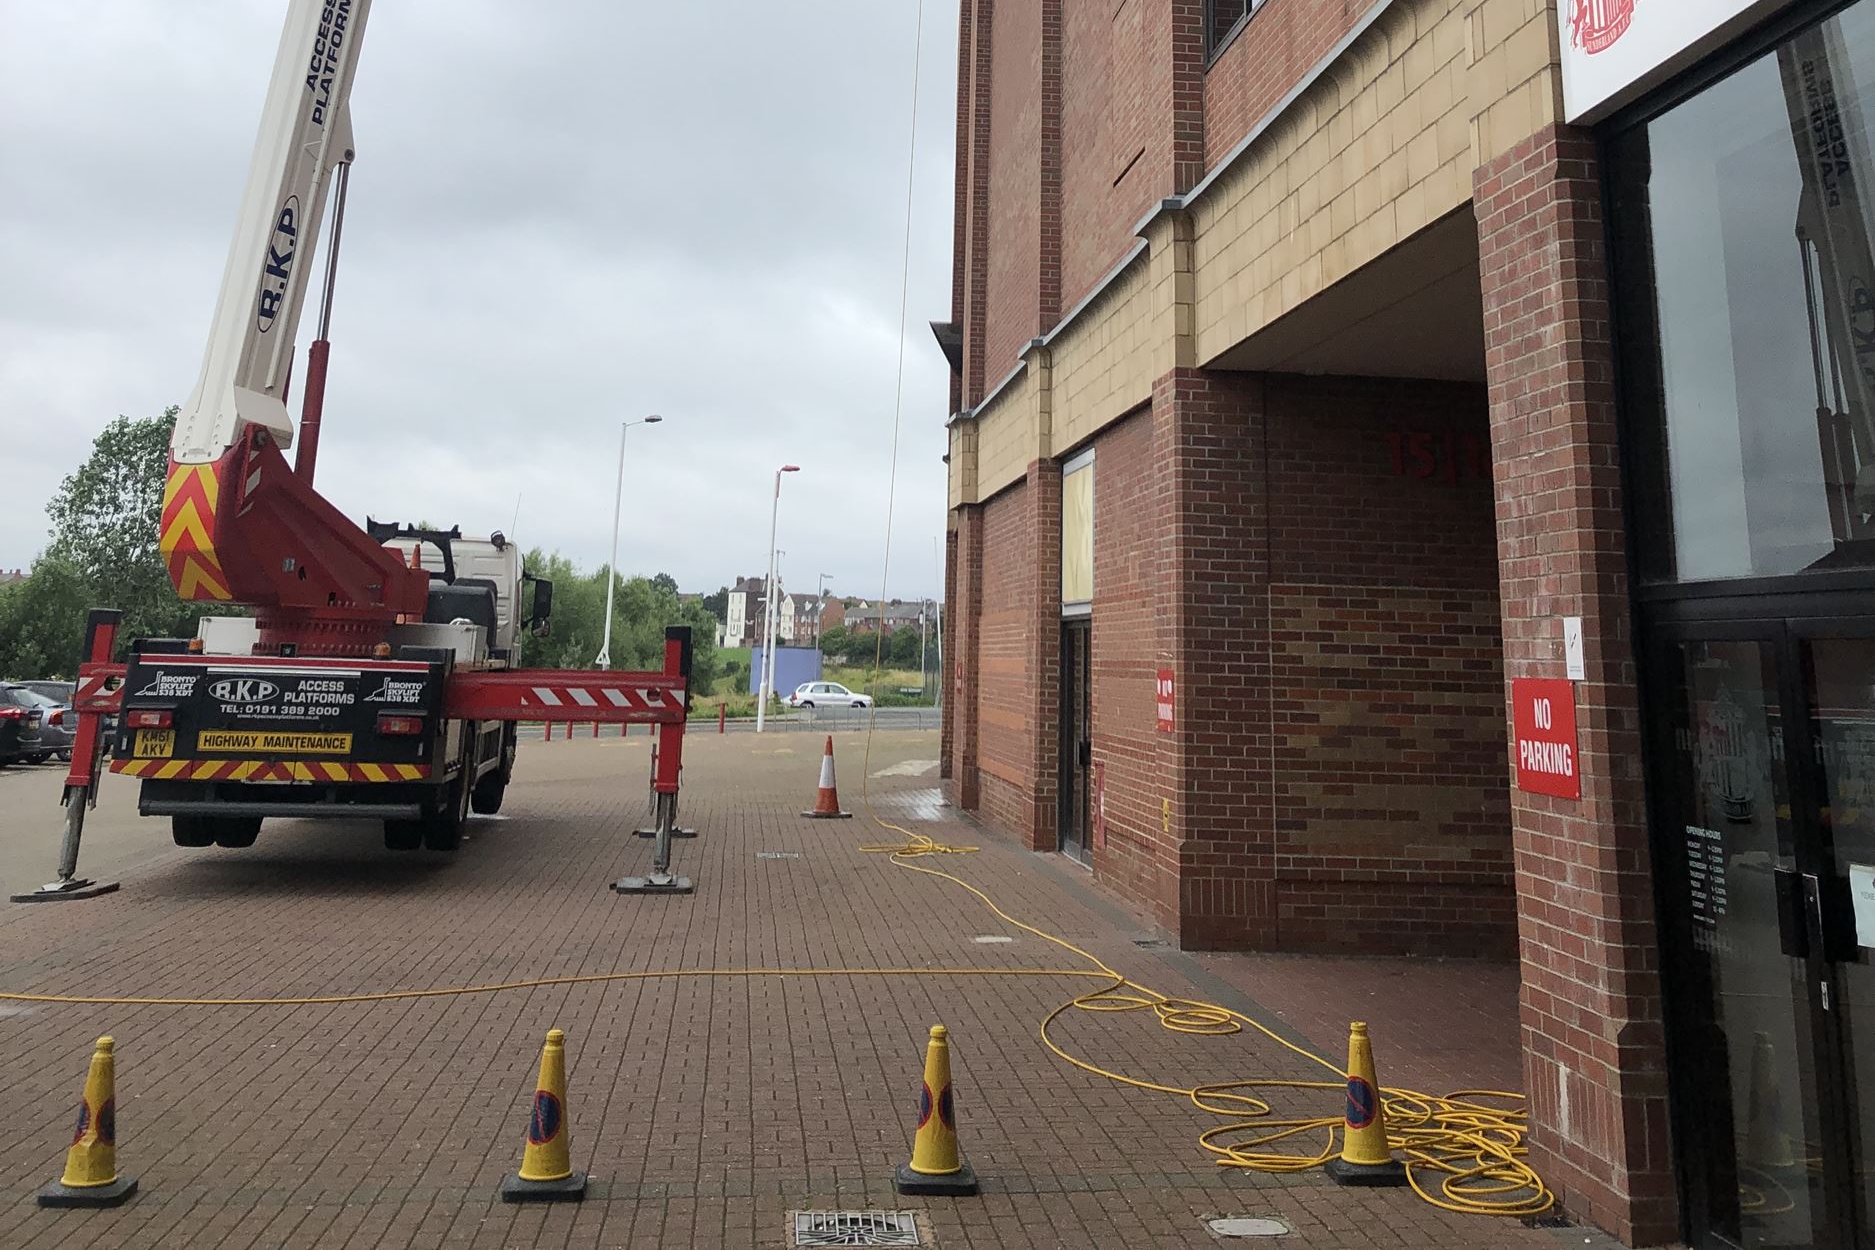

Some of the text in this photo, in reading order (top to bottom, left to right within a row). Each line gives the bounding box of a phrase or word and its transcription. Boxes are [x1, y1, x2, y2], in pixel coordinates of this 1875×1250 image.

[161, 676, 197, 684] BRONTO
[298, 680, 344, 692] ACCESS
[388, 682, 423, 690] BRONTO
[284, 692, 355, 705] PLATFORMS
[246, 705, 276, 714] 0191
[308, 706, 340, 716] 2000
[1533, 697, 1552, 730] NO
[203, 735, 347, 750] HIGHWAY MAINTENANCE
[142, 743, 167, 756] AKV
[1520, 739, 1573, 777] PARKING
